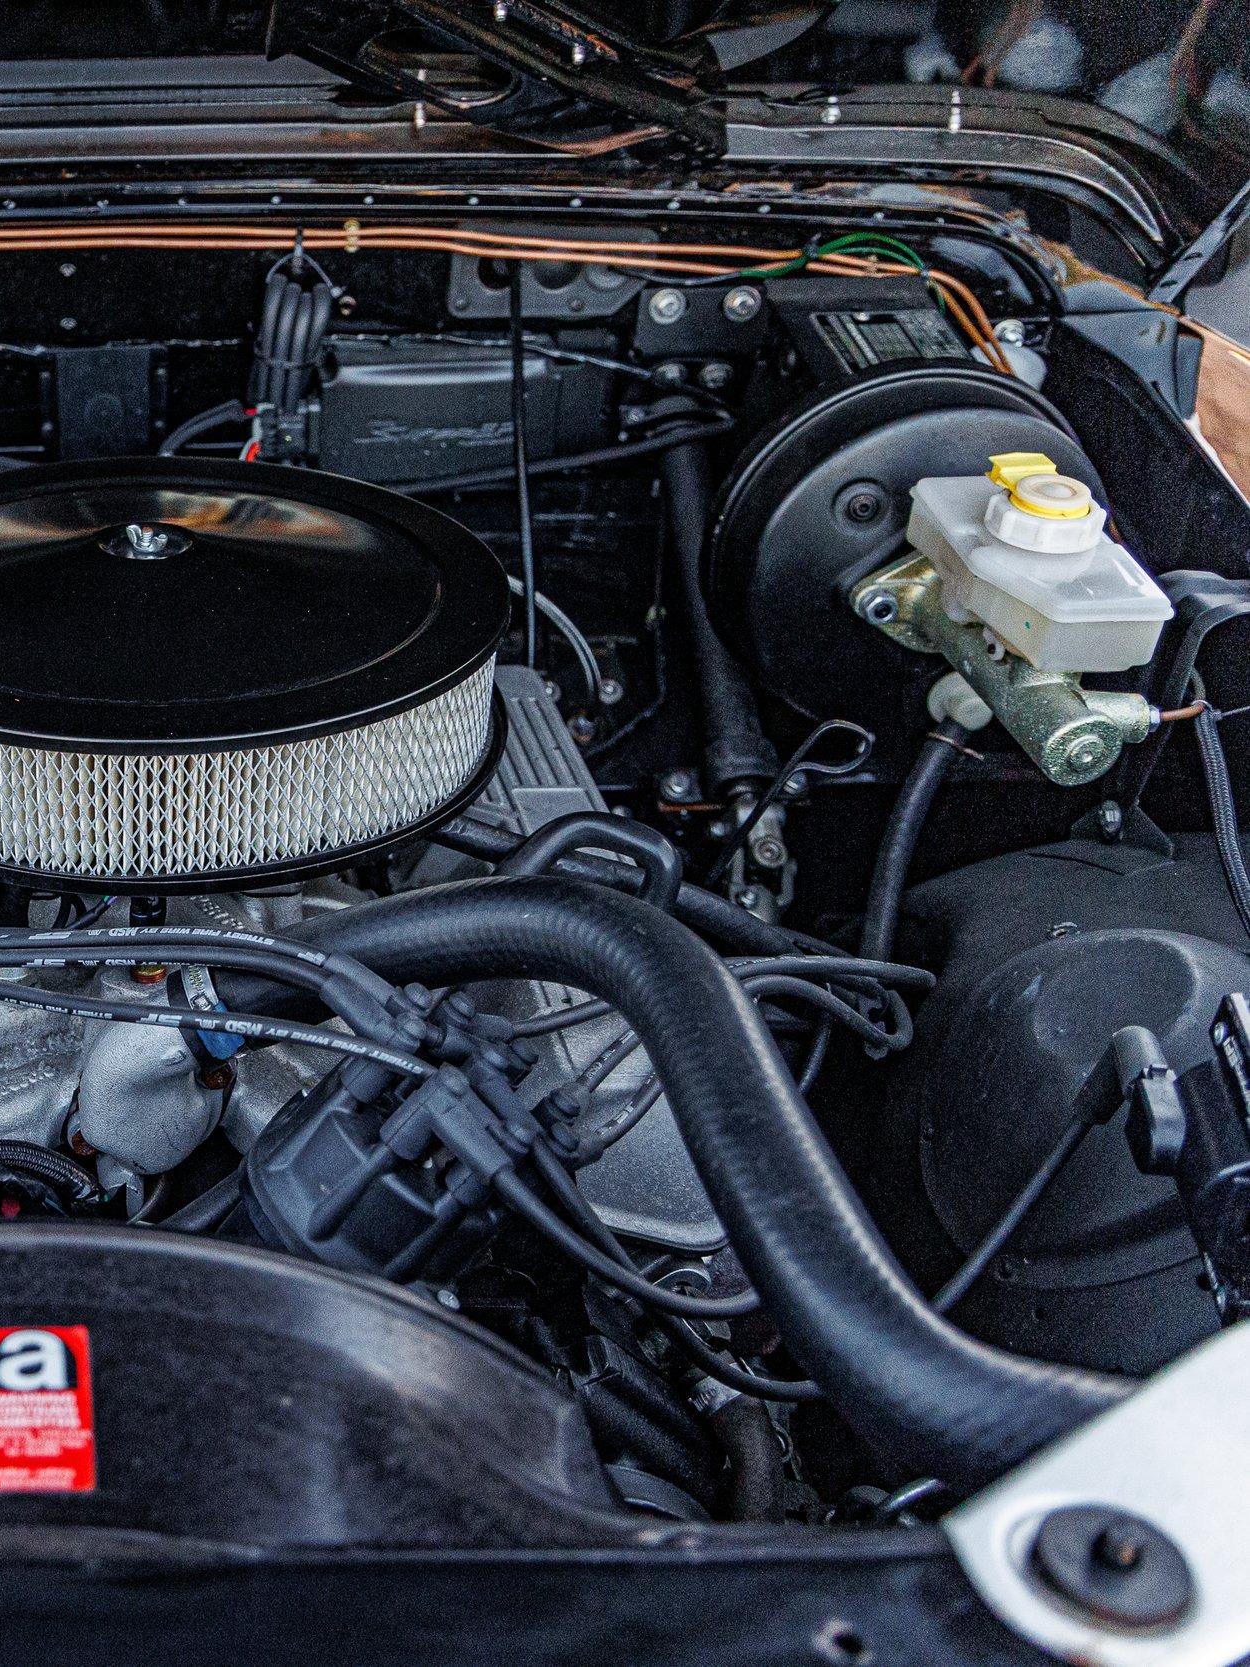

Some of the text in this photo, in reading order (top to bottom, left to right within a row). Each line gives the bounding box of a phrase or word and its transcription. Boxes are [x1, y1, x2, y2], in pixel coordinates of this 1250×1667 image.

[108, 927, 139, 937] MSD
[139, 927, 158, 935] BY
[160, 927, 191, 936] WIRE
[191, 928, 222, 938] FIRE
[223, 931, 275, 946] STREET
[71, 1009, 113, 1020] STREET
[224, 1019, 263, 1035] MSD
[264, 1027, 289, 1037] BY
[290, 1031, 329, 1045] WIRE
[330, 1039, 367, 1055] FIRE
[368, 1050, 424, 1074] STREET
